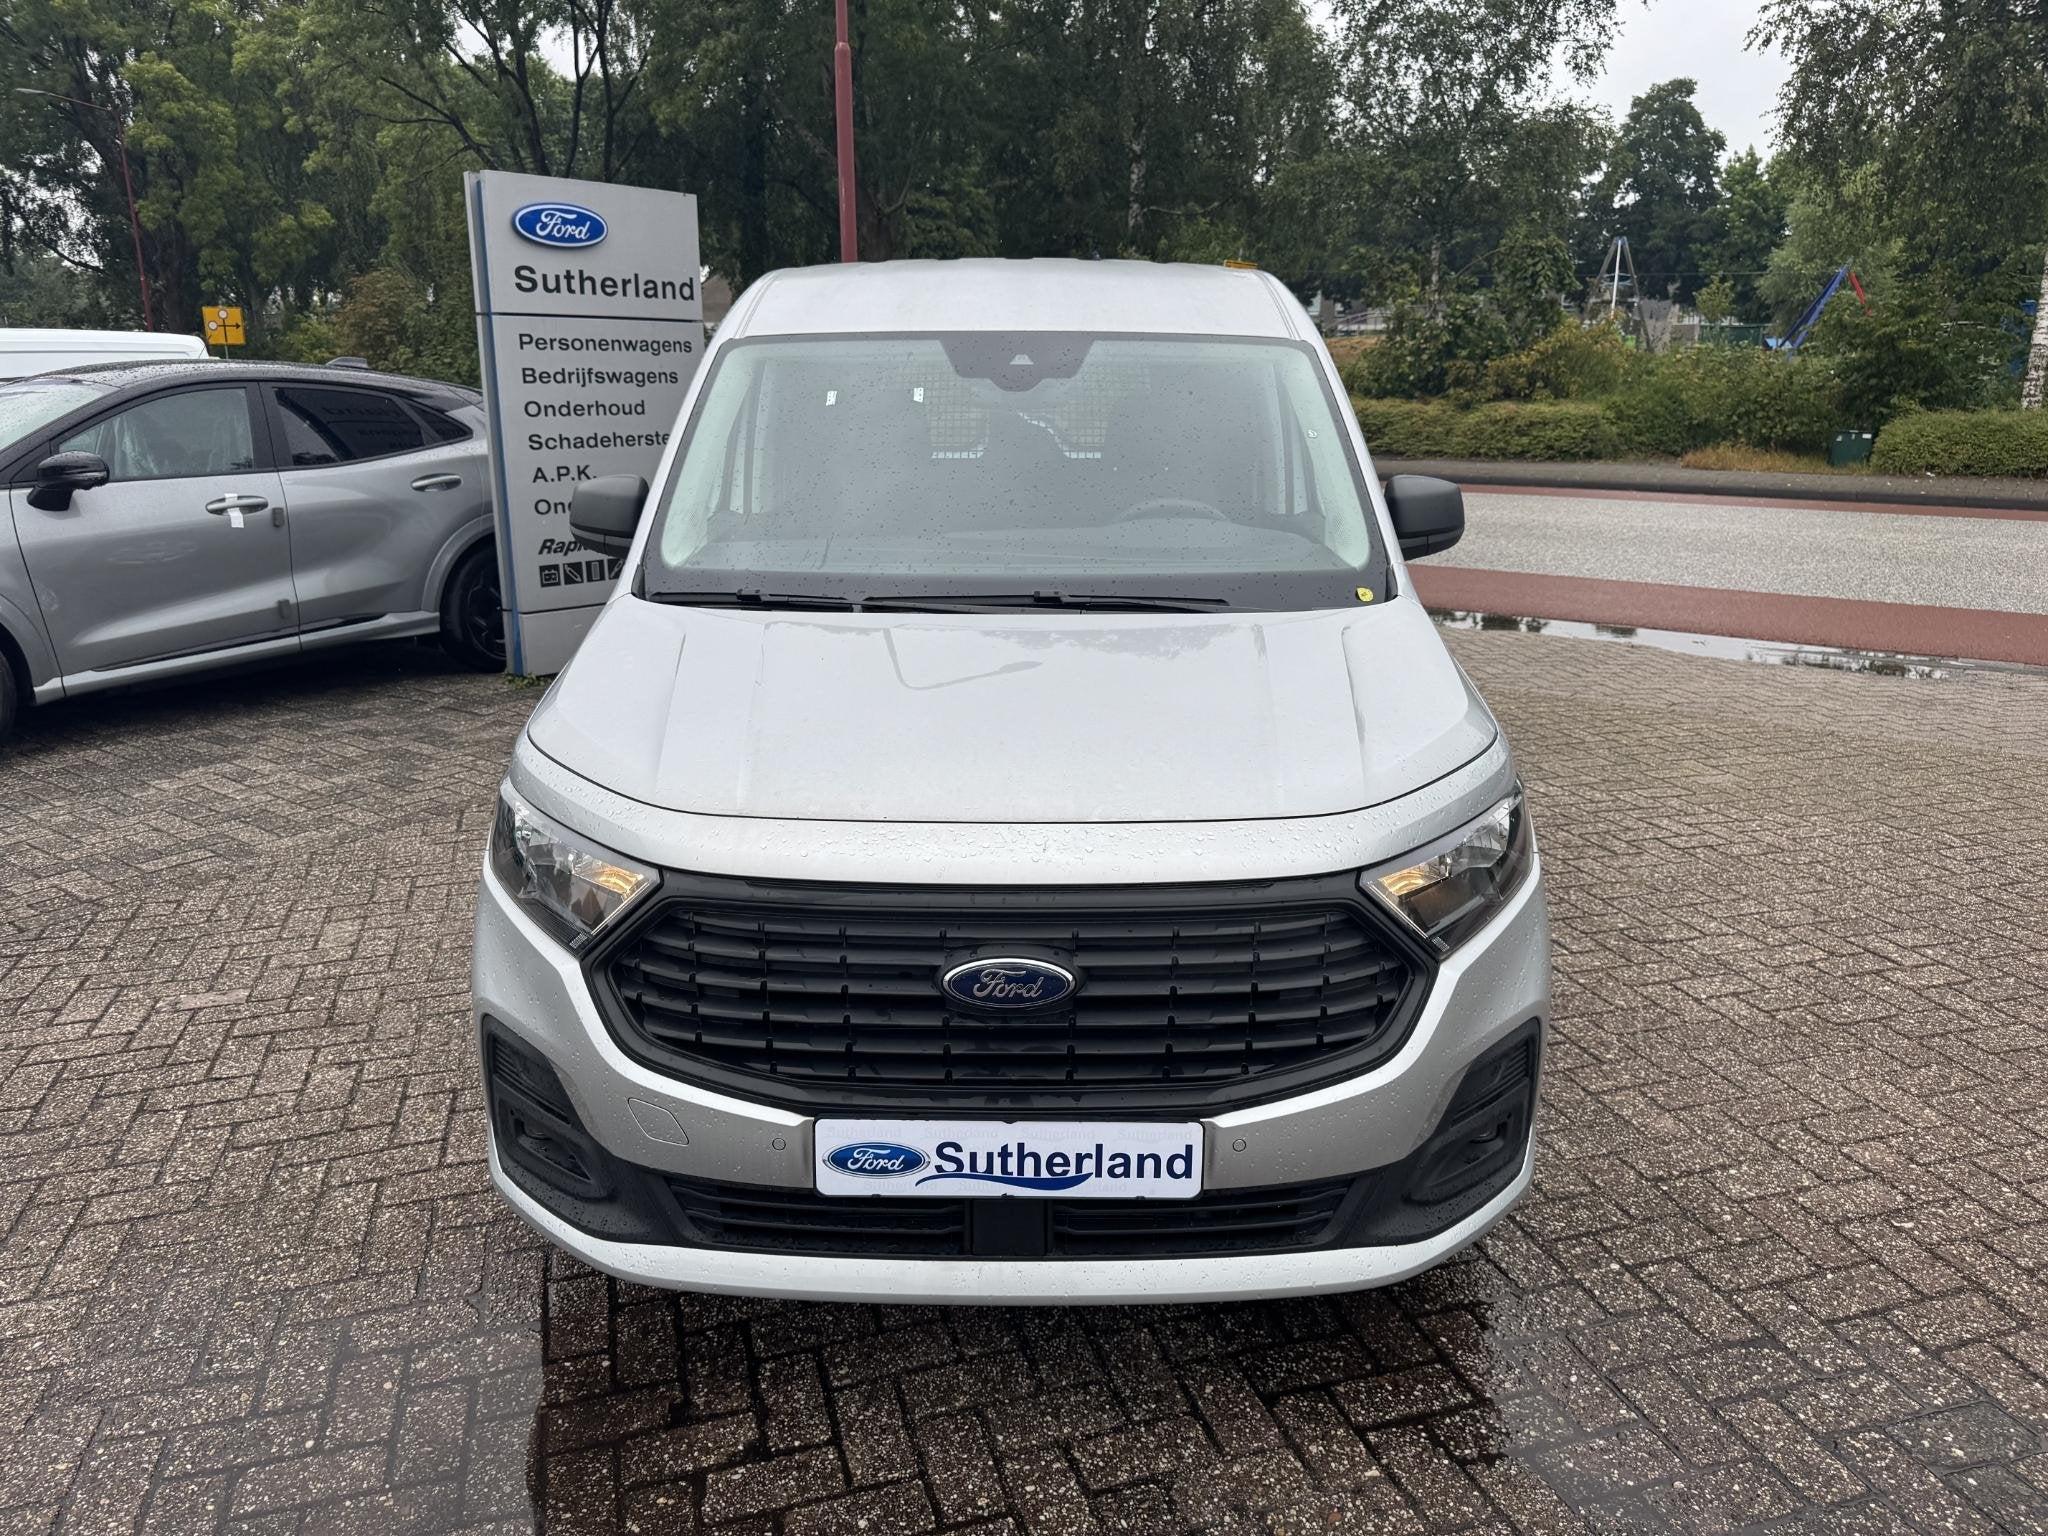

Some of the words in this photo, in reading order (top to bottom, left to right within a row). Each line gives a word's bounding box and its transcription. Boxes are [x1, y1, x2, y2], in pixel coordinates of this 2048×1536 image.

[513, 265, 695, 301] Sutherland
[518, 333, 693, 356] Personenwagens
[521, 367, 679, 387] Bedrijfswagens
[523, 399, 646, 418] Onderhoud
[532, 465, 597, 483] A.P.K.
[972, 968, 1043, 998] Ford
[934, 1141, 1193, 1179] Sutherland
